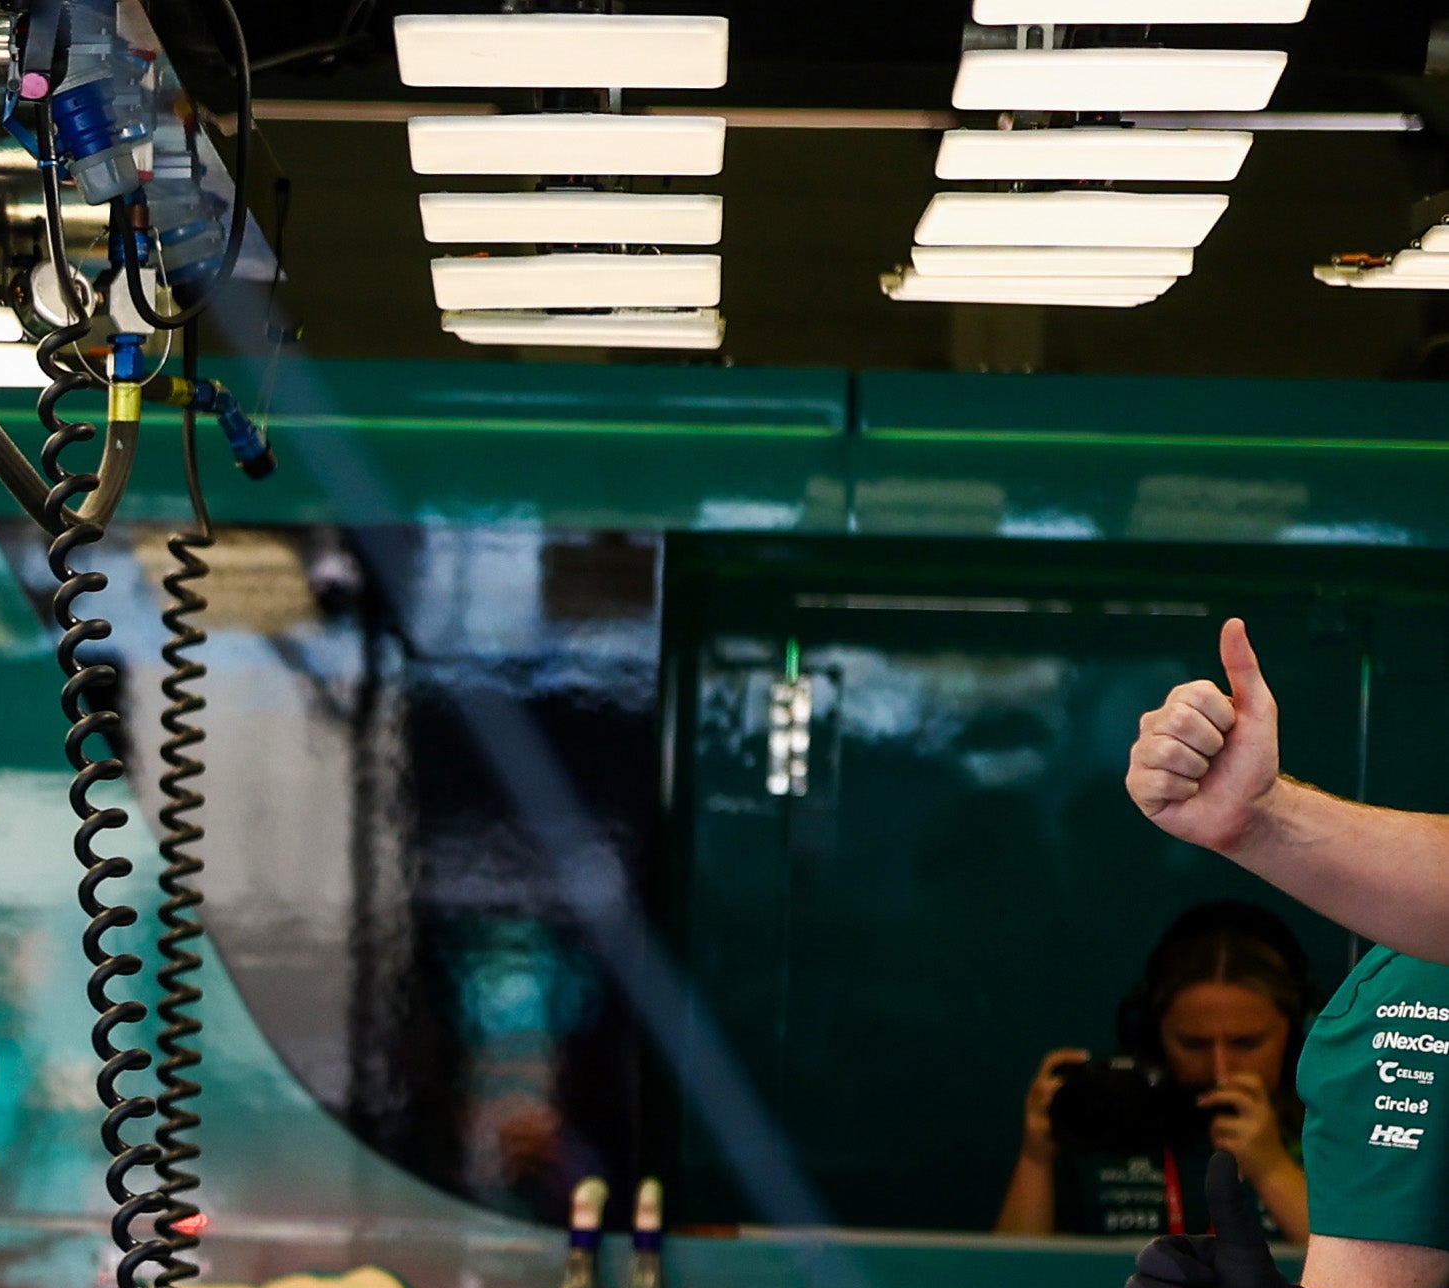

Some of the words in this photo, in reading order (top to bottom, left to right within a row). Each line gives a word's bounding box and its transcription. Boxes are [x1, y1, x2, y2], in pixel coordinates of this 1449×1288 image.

[1376, 1001, 1449, 1022] coinbas
[1396, 1068, 1434, 1082] CELSIUS
[1370, 1124, 1424, 1146] HRC
